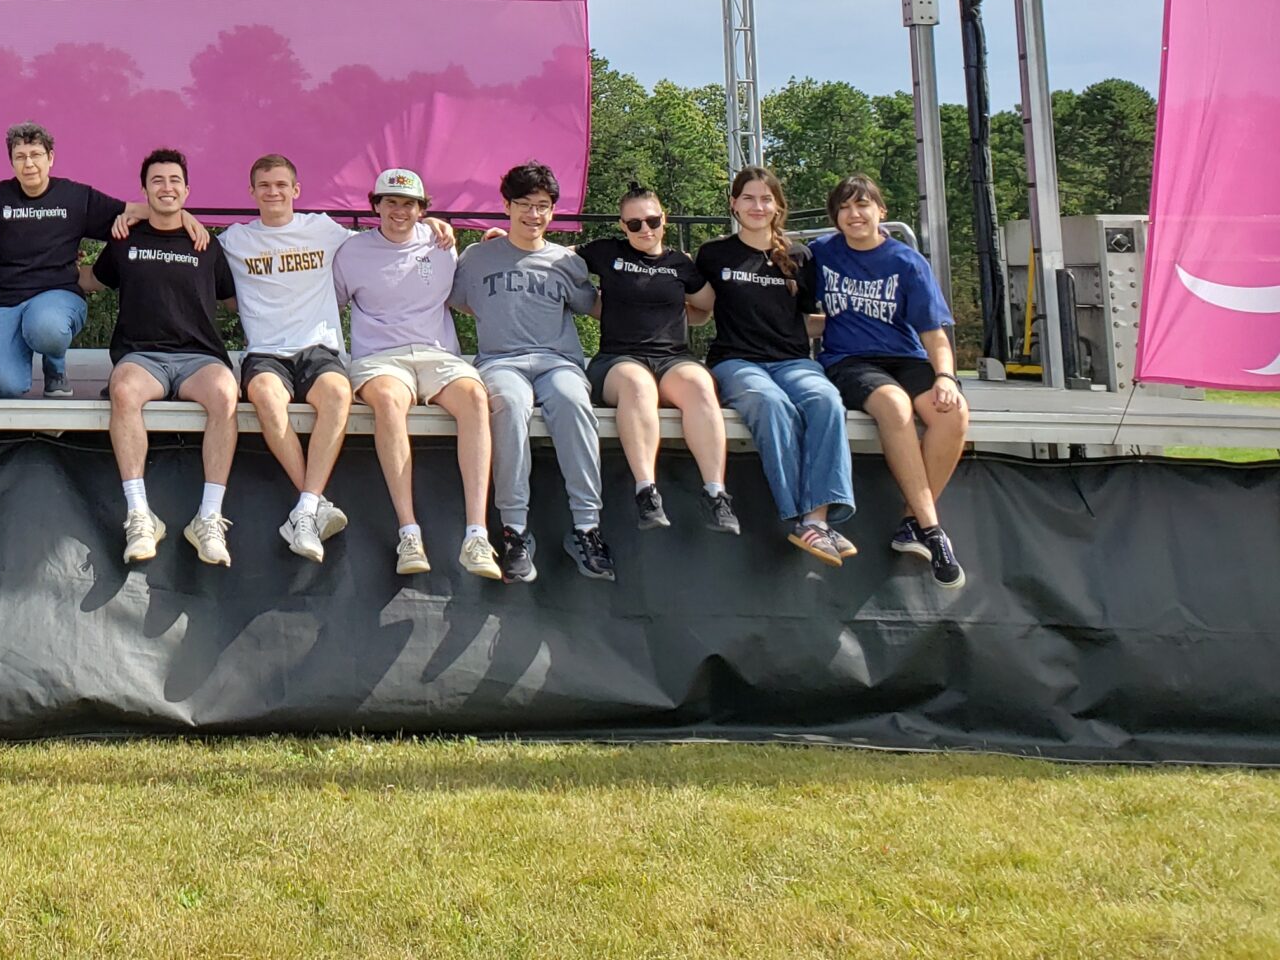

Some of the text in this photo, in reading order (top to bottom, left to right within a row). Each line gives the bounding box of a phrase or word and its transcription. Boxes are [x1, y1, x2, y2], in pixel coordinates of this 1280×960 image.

[12, 206, 67, 220] TCNJ Engineering
[138, 249, 198, 267] TCNJ Engineering
[245, 250, 324, 275] NEW JERSEY
[483, 270, 562, 303] TCNJ
[732, 271, 752, 282] TCNJ
[822, 265, 899, 300] THE COLLEGE OF
[825, 293, 897, 324] NEW JERSEY
